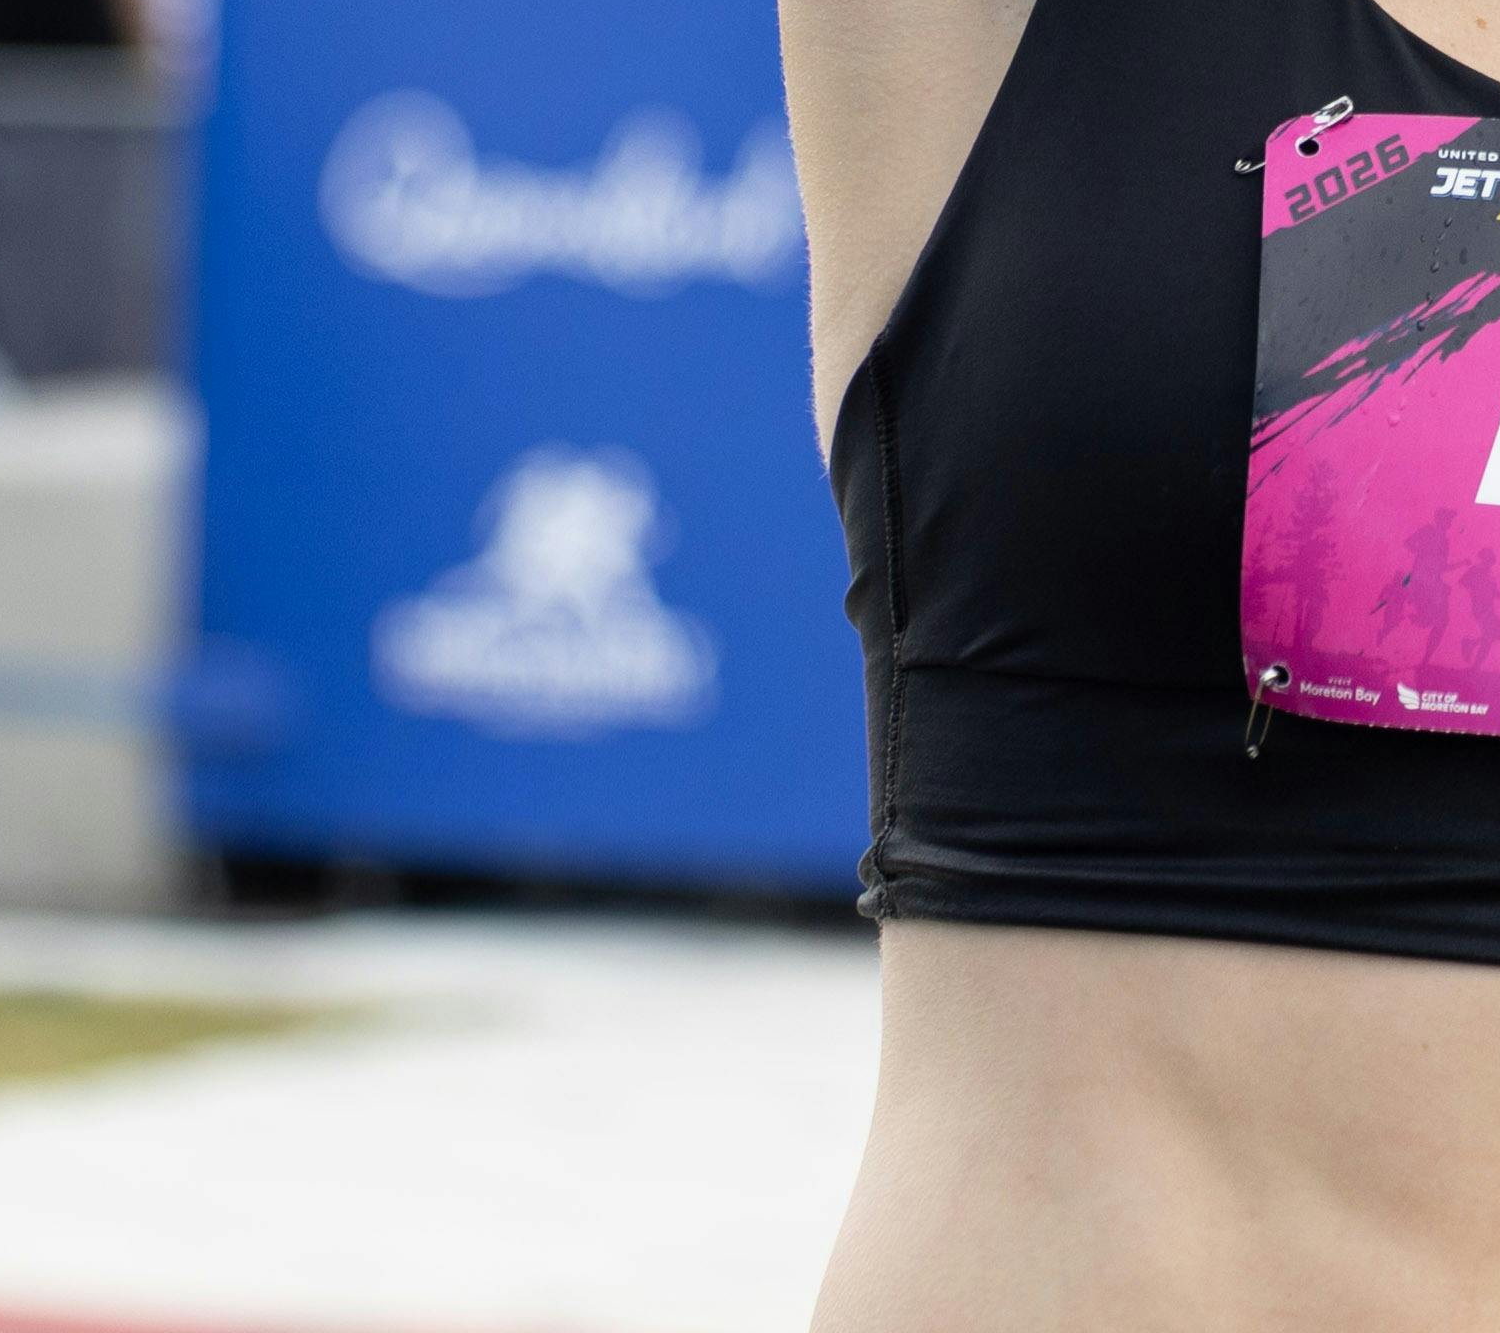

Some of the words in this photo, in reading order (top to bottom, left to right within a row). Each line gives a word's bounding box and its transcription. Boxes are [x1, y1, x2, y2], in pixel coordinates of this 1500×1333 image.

[1438, 148, 1499, 163] UNITED
[1284, 133, 1410, 223] 2026
[1300, 681, 1353, 700] Moreton
[1355, 686, 1382, 706] Bay
[1421, 691, 1443, 703] CITY
[1444, 692, 1458, 704] OF
[1420, 701, 1469, 714] MORETON
[1470, 704, 1490, 715] BAY
